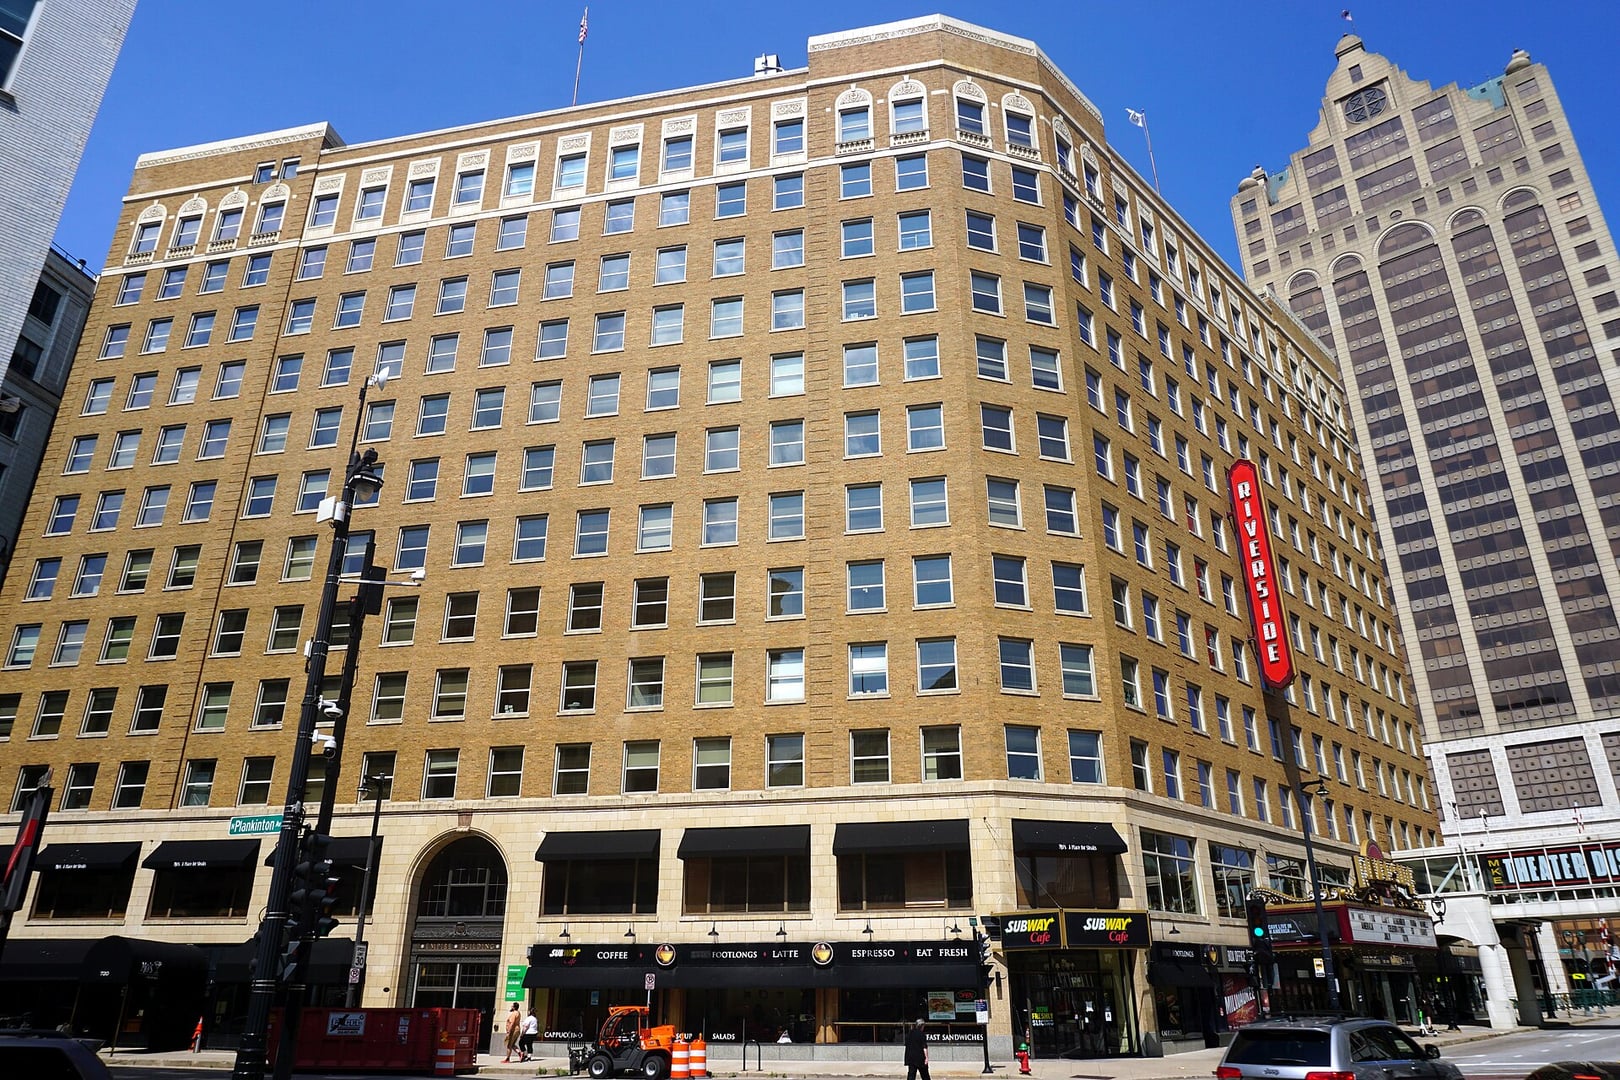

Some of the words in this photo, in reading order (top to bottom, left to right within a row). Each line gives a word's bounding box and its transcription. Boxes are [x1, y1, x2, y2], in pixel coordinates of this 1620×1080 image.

[1237, 482, 1280, 663] RIVERSIDE
[234, 818, 274, 832] Plankinton
[1488, 859, 1503, 884] MKE
[1502, 852, 1588, 883] THEATER
[1005, 917, 1054, 933] SUBWAY
[1083, 916, 1132, 930] SUBWAY
[1030, 932, 1051, 944] Cafe
[1108, 931, 1129, 943] Cafe
[549, 949, 581, 957] SUBWAY
[597, 951, 628, 960] COFFEE
[712, 951, 758, 959] FOOTLONGS
[772, 950, 799, 958] LATTE
[852, 949, 895, 958] ESPRESSO
[916, 949, 933, 957] EAT
[939, 949, 968, 957] FRESH
